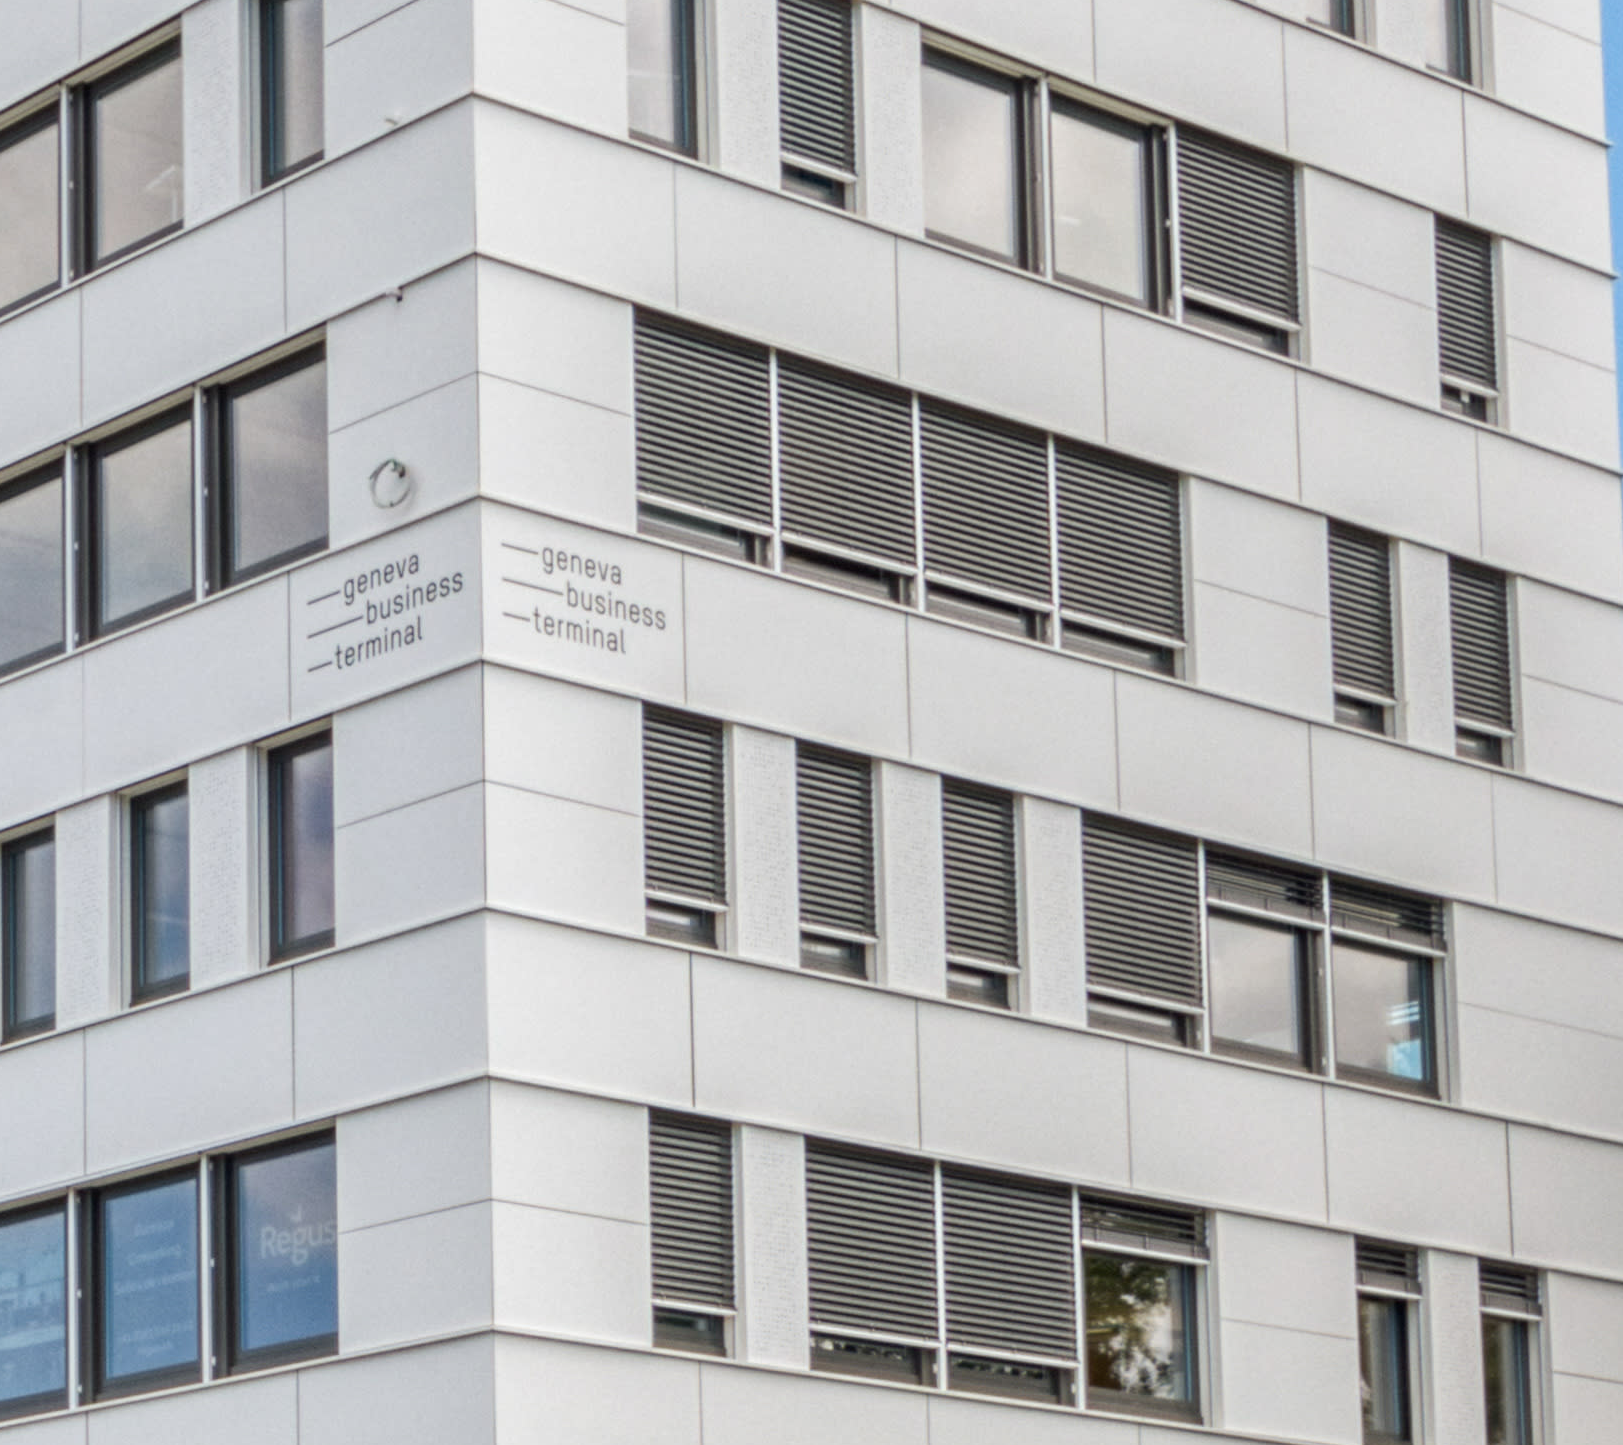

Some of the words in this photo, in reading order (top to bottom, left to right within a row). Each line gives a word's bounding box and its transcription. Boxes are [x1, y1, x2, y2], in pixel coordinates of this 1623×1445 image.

[344, 554, 419, 606] geneva
[542, 547, 622, 585] geneva
[367, 572, 463, 625] business
[567, 581, 666, 630] business
[335, 615, 423, 670] terminal
[533, 606, 626, 654] terminal
